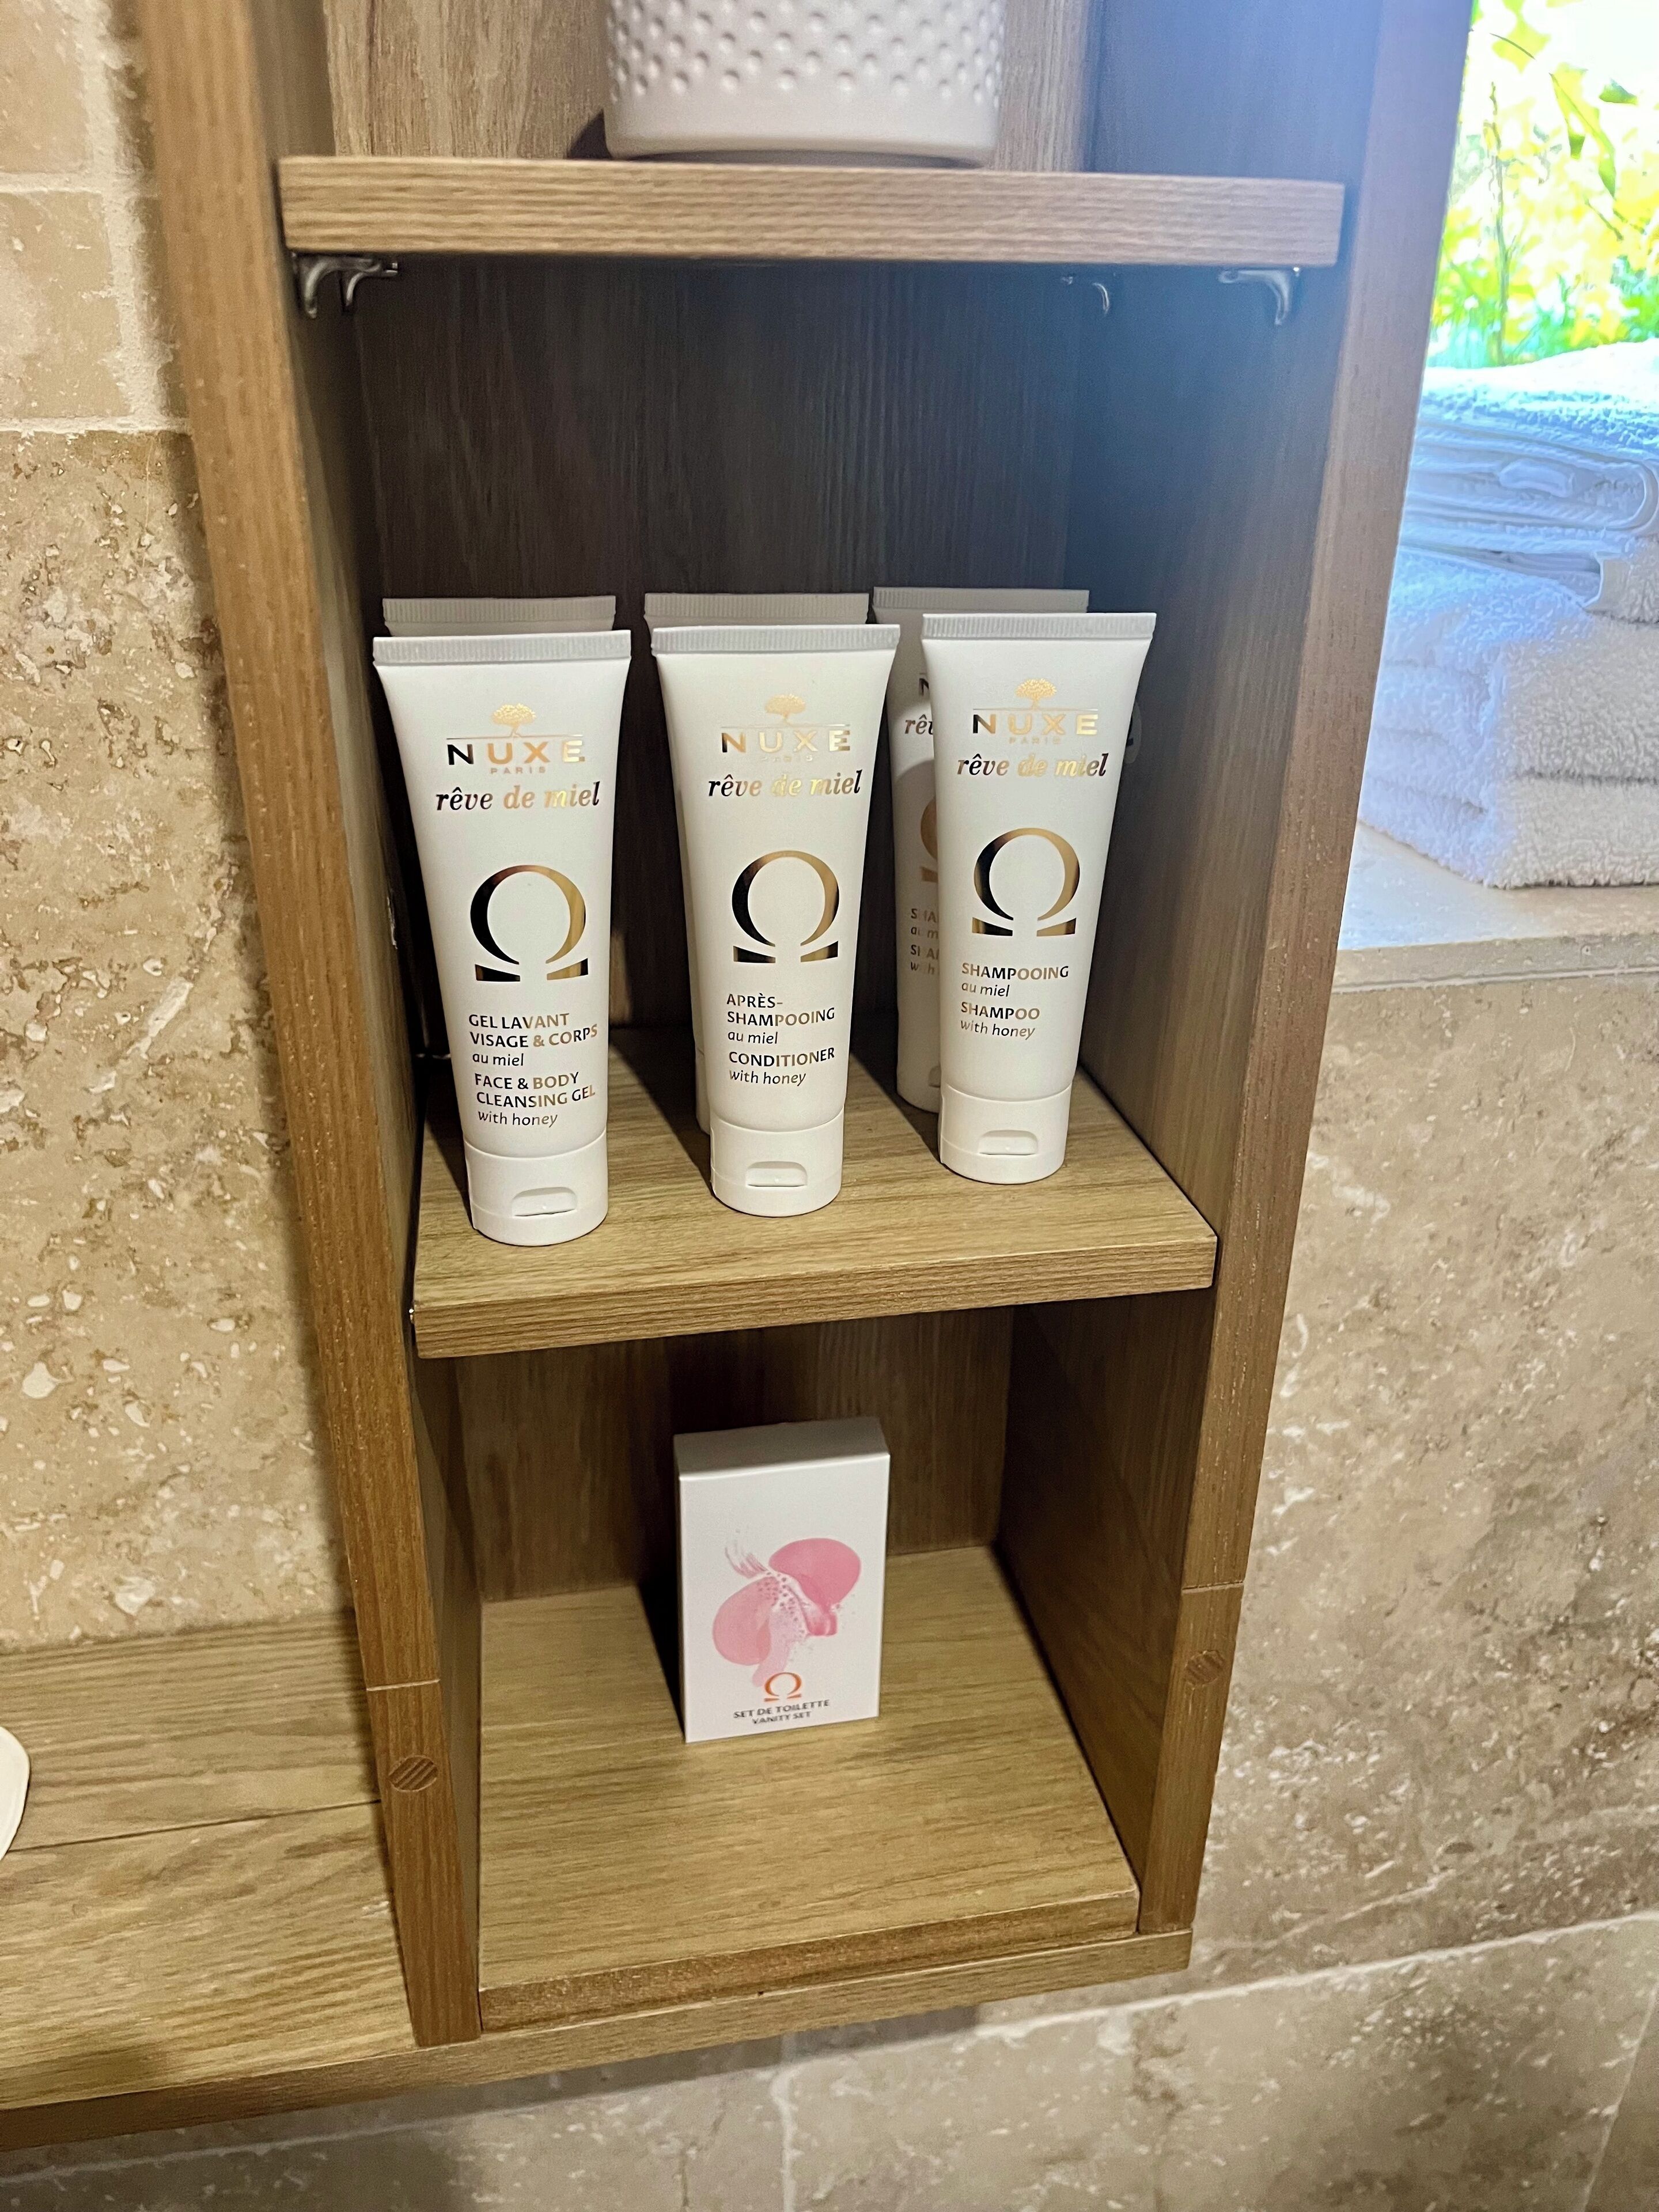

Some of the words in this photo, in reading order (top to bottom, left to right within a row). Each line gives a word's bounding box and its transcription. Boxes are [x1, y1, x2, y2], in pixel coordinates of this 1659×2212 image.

[972, 714, 1098, 735] NUXE
[722, 730, 850, 753] NUXE
[447, 740, 585, 765] NUXE
[490, 766, 546, 775] PARIS
[957, 753, 1009, 776] rêve
[1017, 752, 1048, 777] de
[1055, 752, 1109, 777] miel
[709, 774, 762, 797] rêve
[771, 774, 802, 797] de
[810, 769, 862, 795] miel
[436, 786, 493, 810] rêve
[503, 785, 535, 809] de
[544, 781, 600, 807] miel
[961, 962, 1069, 980] SHAMPOOING
[961, 982, 976, 993] au
[980, 984, 1010, 997] miel
[726, 993, 783, 1008] APRÈS-
[727, 1007, 835, 1027] SHAMPOOING
[961, 1001, 1040, 1020] SHAMPOO
[469, 1014, 498, 1028] GEL
[502, 1013, 569, 1029] LAVANT
[960, 1020, 988, 1034] with
[992, 1024, 1035, 1040] honey
[469, 1031, 529, 1047] VISAGE
[533, 1035, 545, 1047] &
[549, 1024, 598, 1046] CORPS
[728, 1031, 744, 1042] au
[748, 1031, 778, 1044] miel
[472, 1053, 488, 1064] au
[493, 1053, 524, 1066] miel
[729, 1047, 835, 1067] CONDITIONER
[475, 1073, 513, 1089] FACE
[517, 1078, 529, 1089] &
[533, 1071, 579, 1089] BODY
[729, 1070, 759, 1084] with
[763, 1071, 806, 1086] honey
[476, 1092, 567, 1108] CLEANSING
[572, 1085, 596, 1101] GEL
[478, 1111, 507, 1124] with
[513, 1112, 558, 1128] honey
[733, 1709, 755, 1718] SET
[757, 1707, 772, 1716] DE
[776, 1699, 830, 1713] TOILETTE
[752, 1713, 790, 1724] VANITY
[793, 1711, 811, 1719] SET
